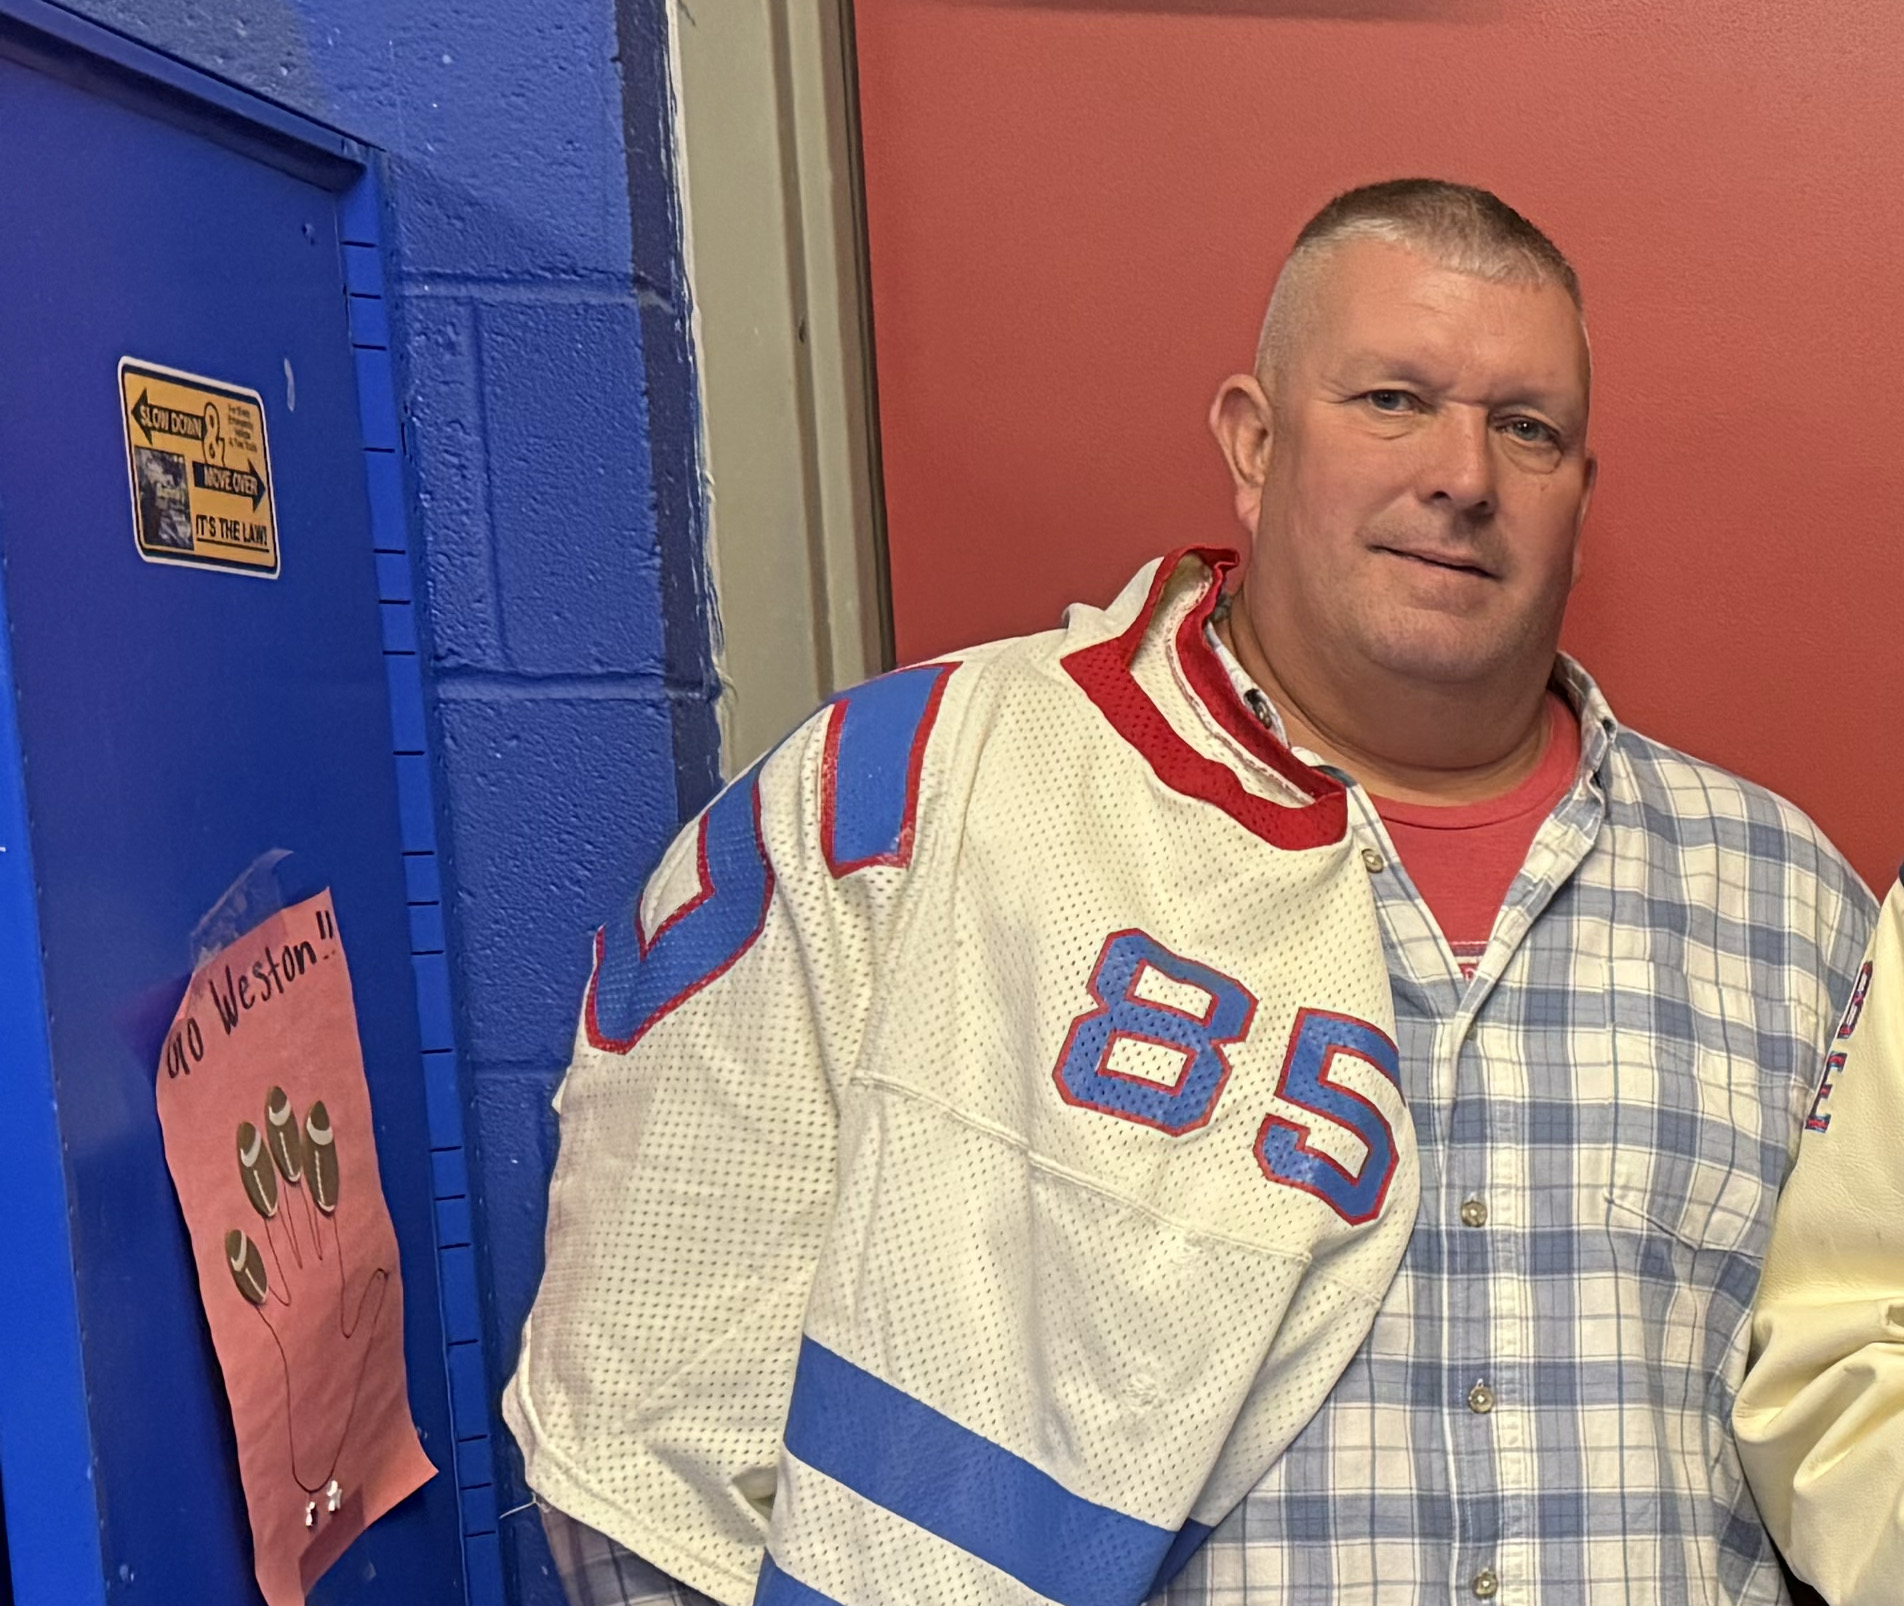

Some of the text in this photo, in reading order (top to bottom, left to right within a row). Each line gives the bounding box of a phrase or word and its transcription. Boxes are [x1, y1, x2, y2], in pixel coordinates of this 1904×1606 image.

[140, 405, 169, 430] SLOW
[171, 412, 202, 439] DOWN
[203, 402, 225, 466] &
[204, 465, 258, 496] MOVE OVER
[196, 514, 268, 546] IT'S THE LAW!
[1052, 928, 1400, 1226] 85
